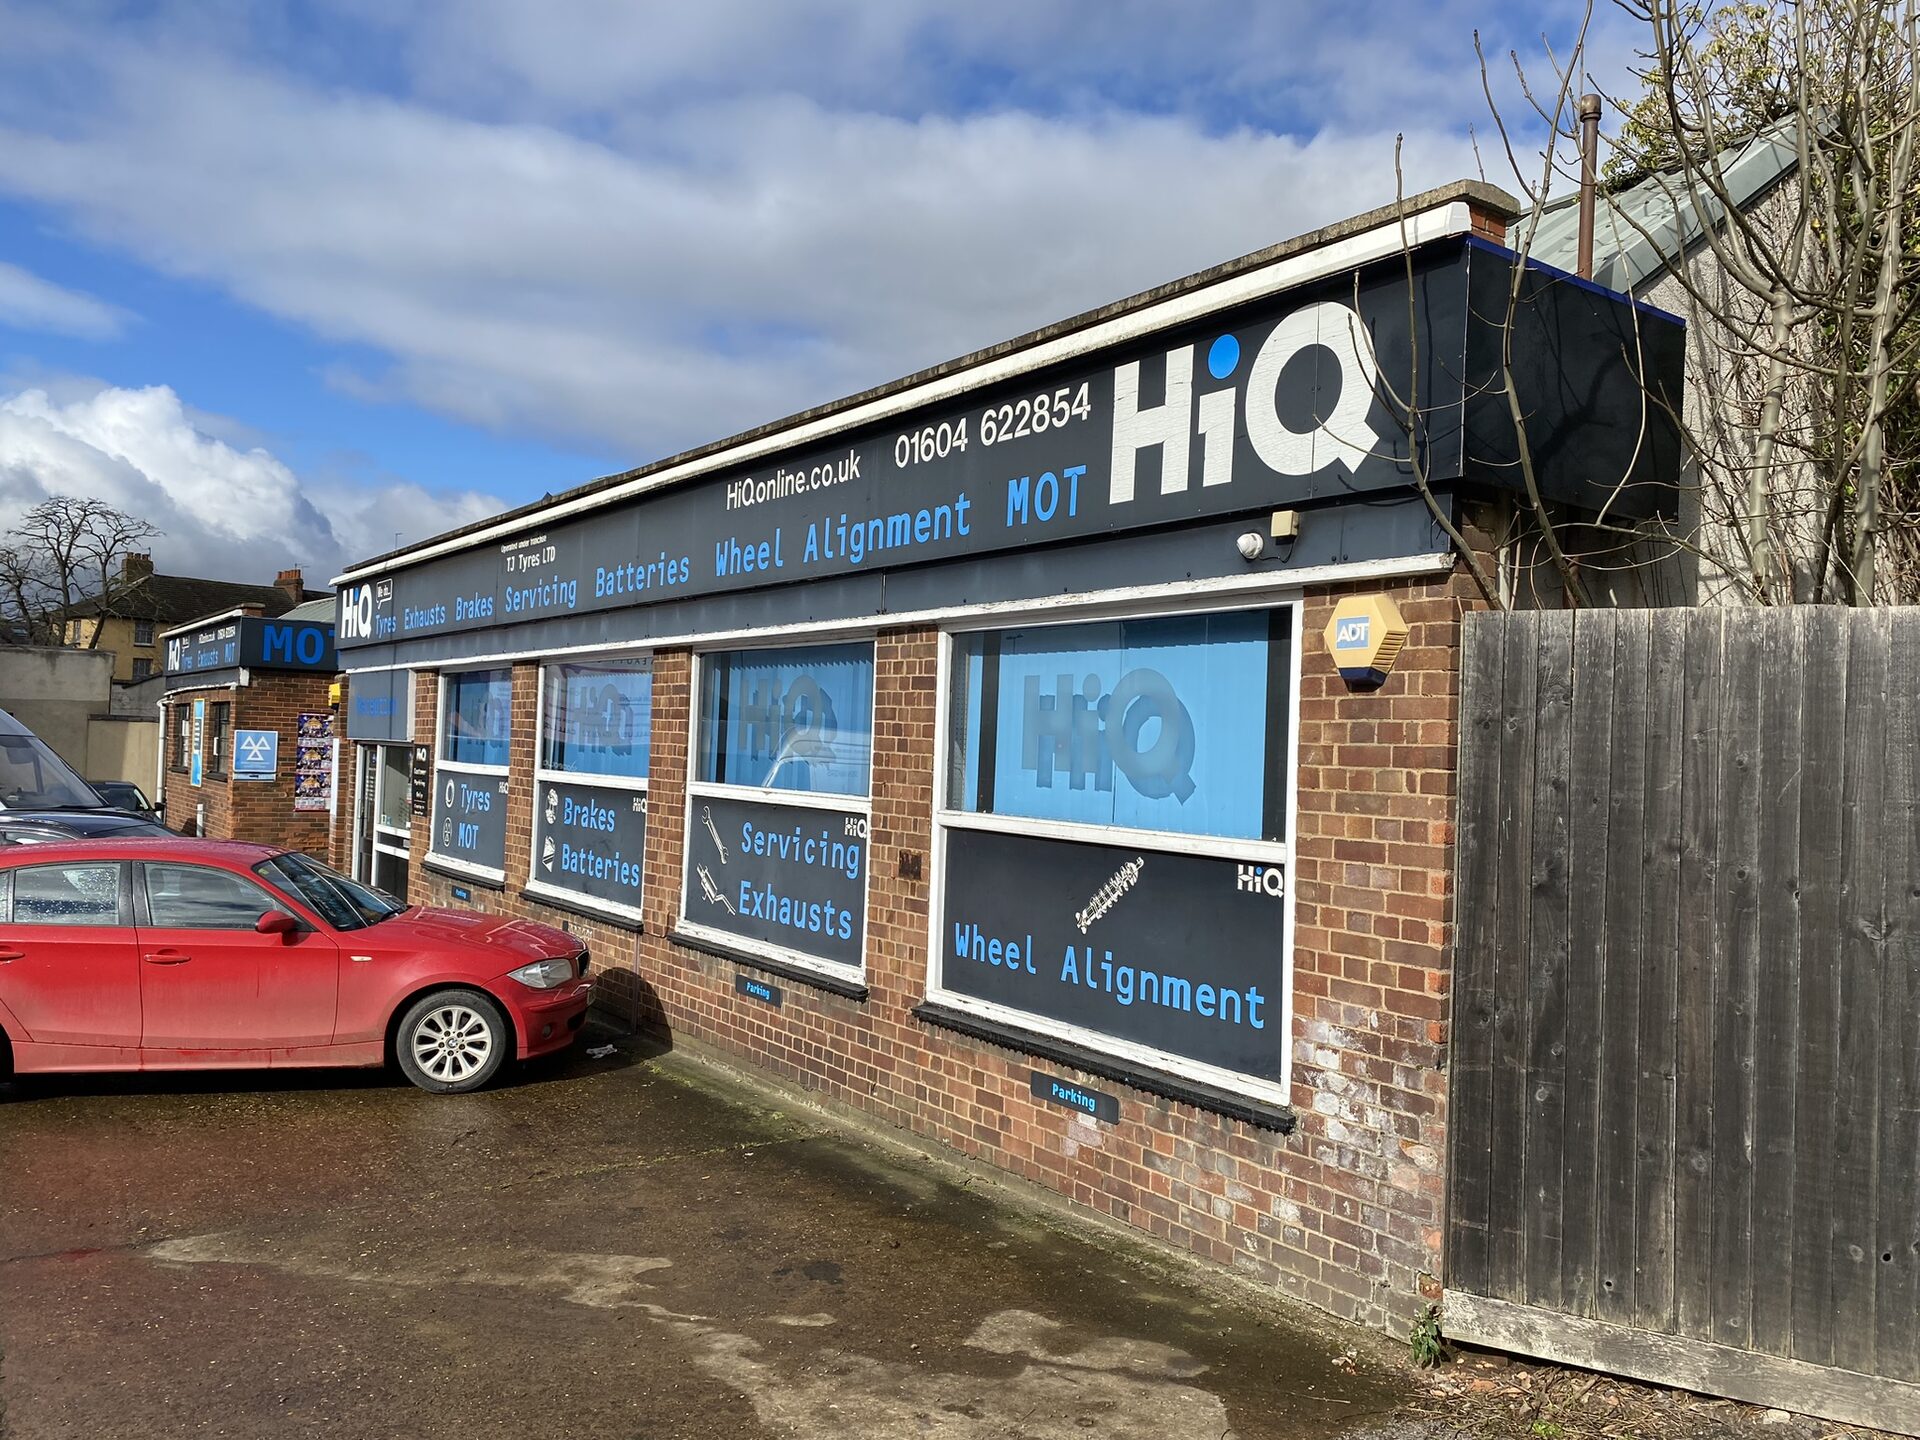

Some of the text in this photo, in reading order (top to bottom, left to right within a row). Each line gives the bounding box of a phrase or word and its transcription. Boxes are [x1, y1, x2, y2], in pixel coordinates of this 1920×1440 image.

[1109, 302, 1380, 505] HiQ
[895, 382, 1091, 469] 01604 622854
[726, 449, 861, 511] HiQonline.co.uk
[375, 464, 1087, 638] Tyres Exhausts Brakes Servicing Batteries Wheel Alignment MOT
[507, 546, 556, 573] TJ Tyres LTD
[340, 583, 373, 639] HiQ
[263, 624, 336, 664] MO
[1337, 622, 1370, 642] ADT
[1021, 667, 1196, 806] HiQ
[460, 783, 490, 814] Tyres
[563, 796, 616, 833] Brakes
[632, 796, 647, 814] HiQ
[458, 822, 479, 850] MOT
[844, 817, 867, 839] HiQ
[561, 842, 640, 889] Batteries
[741, 821, 861, 881] Servicing
[1237, 864, 1284, 898] HiQ
[739, 880, 853, 941] Exhausts
[746, 981, 771, 1001] Parking
[954, 922, 1265, 1031] Wheel Alignment
[1052, 1083, 1096, 1113] Parking
